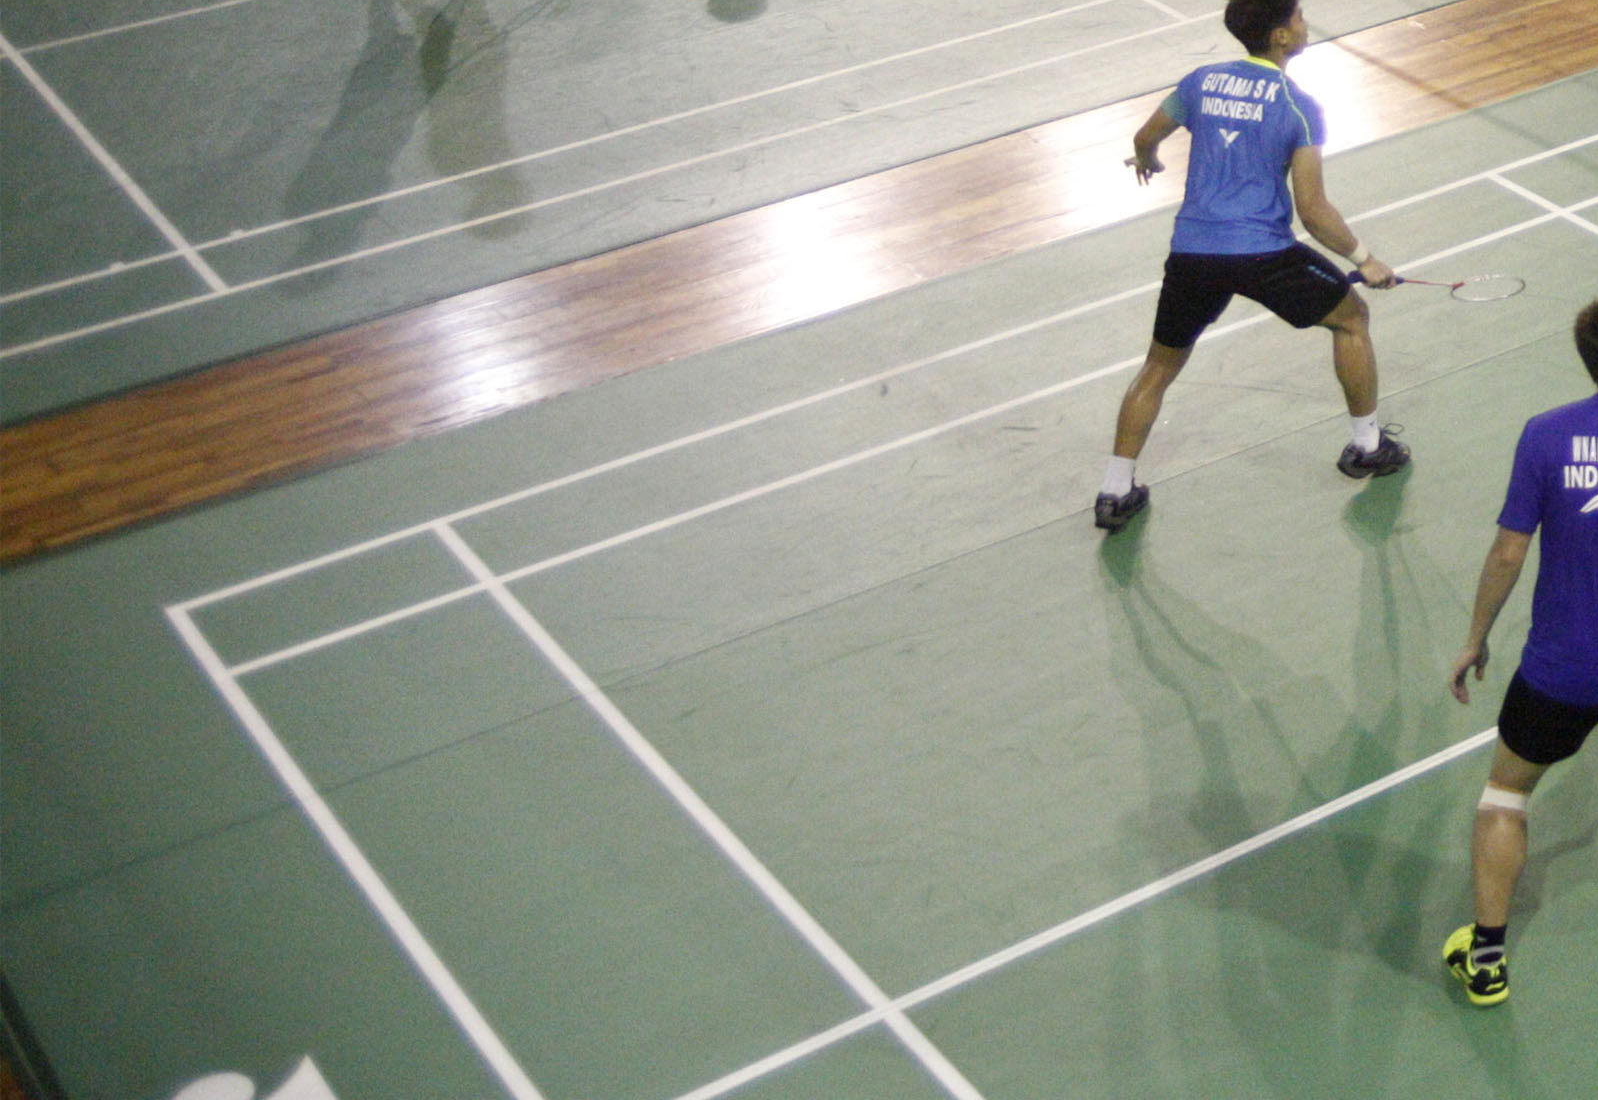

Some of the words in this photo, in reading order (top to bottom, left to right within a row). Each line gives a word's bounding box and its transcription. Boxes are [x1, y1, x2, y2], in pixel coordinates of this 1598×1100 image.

[1202, 73, 1252, 97] GUTAMA
[1253, 79, 1265, 99] S
[1265, 81, 1281, 103] K
[1201, 97, 1264, 122] INDONESIA
